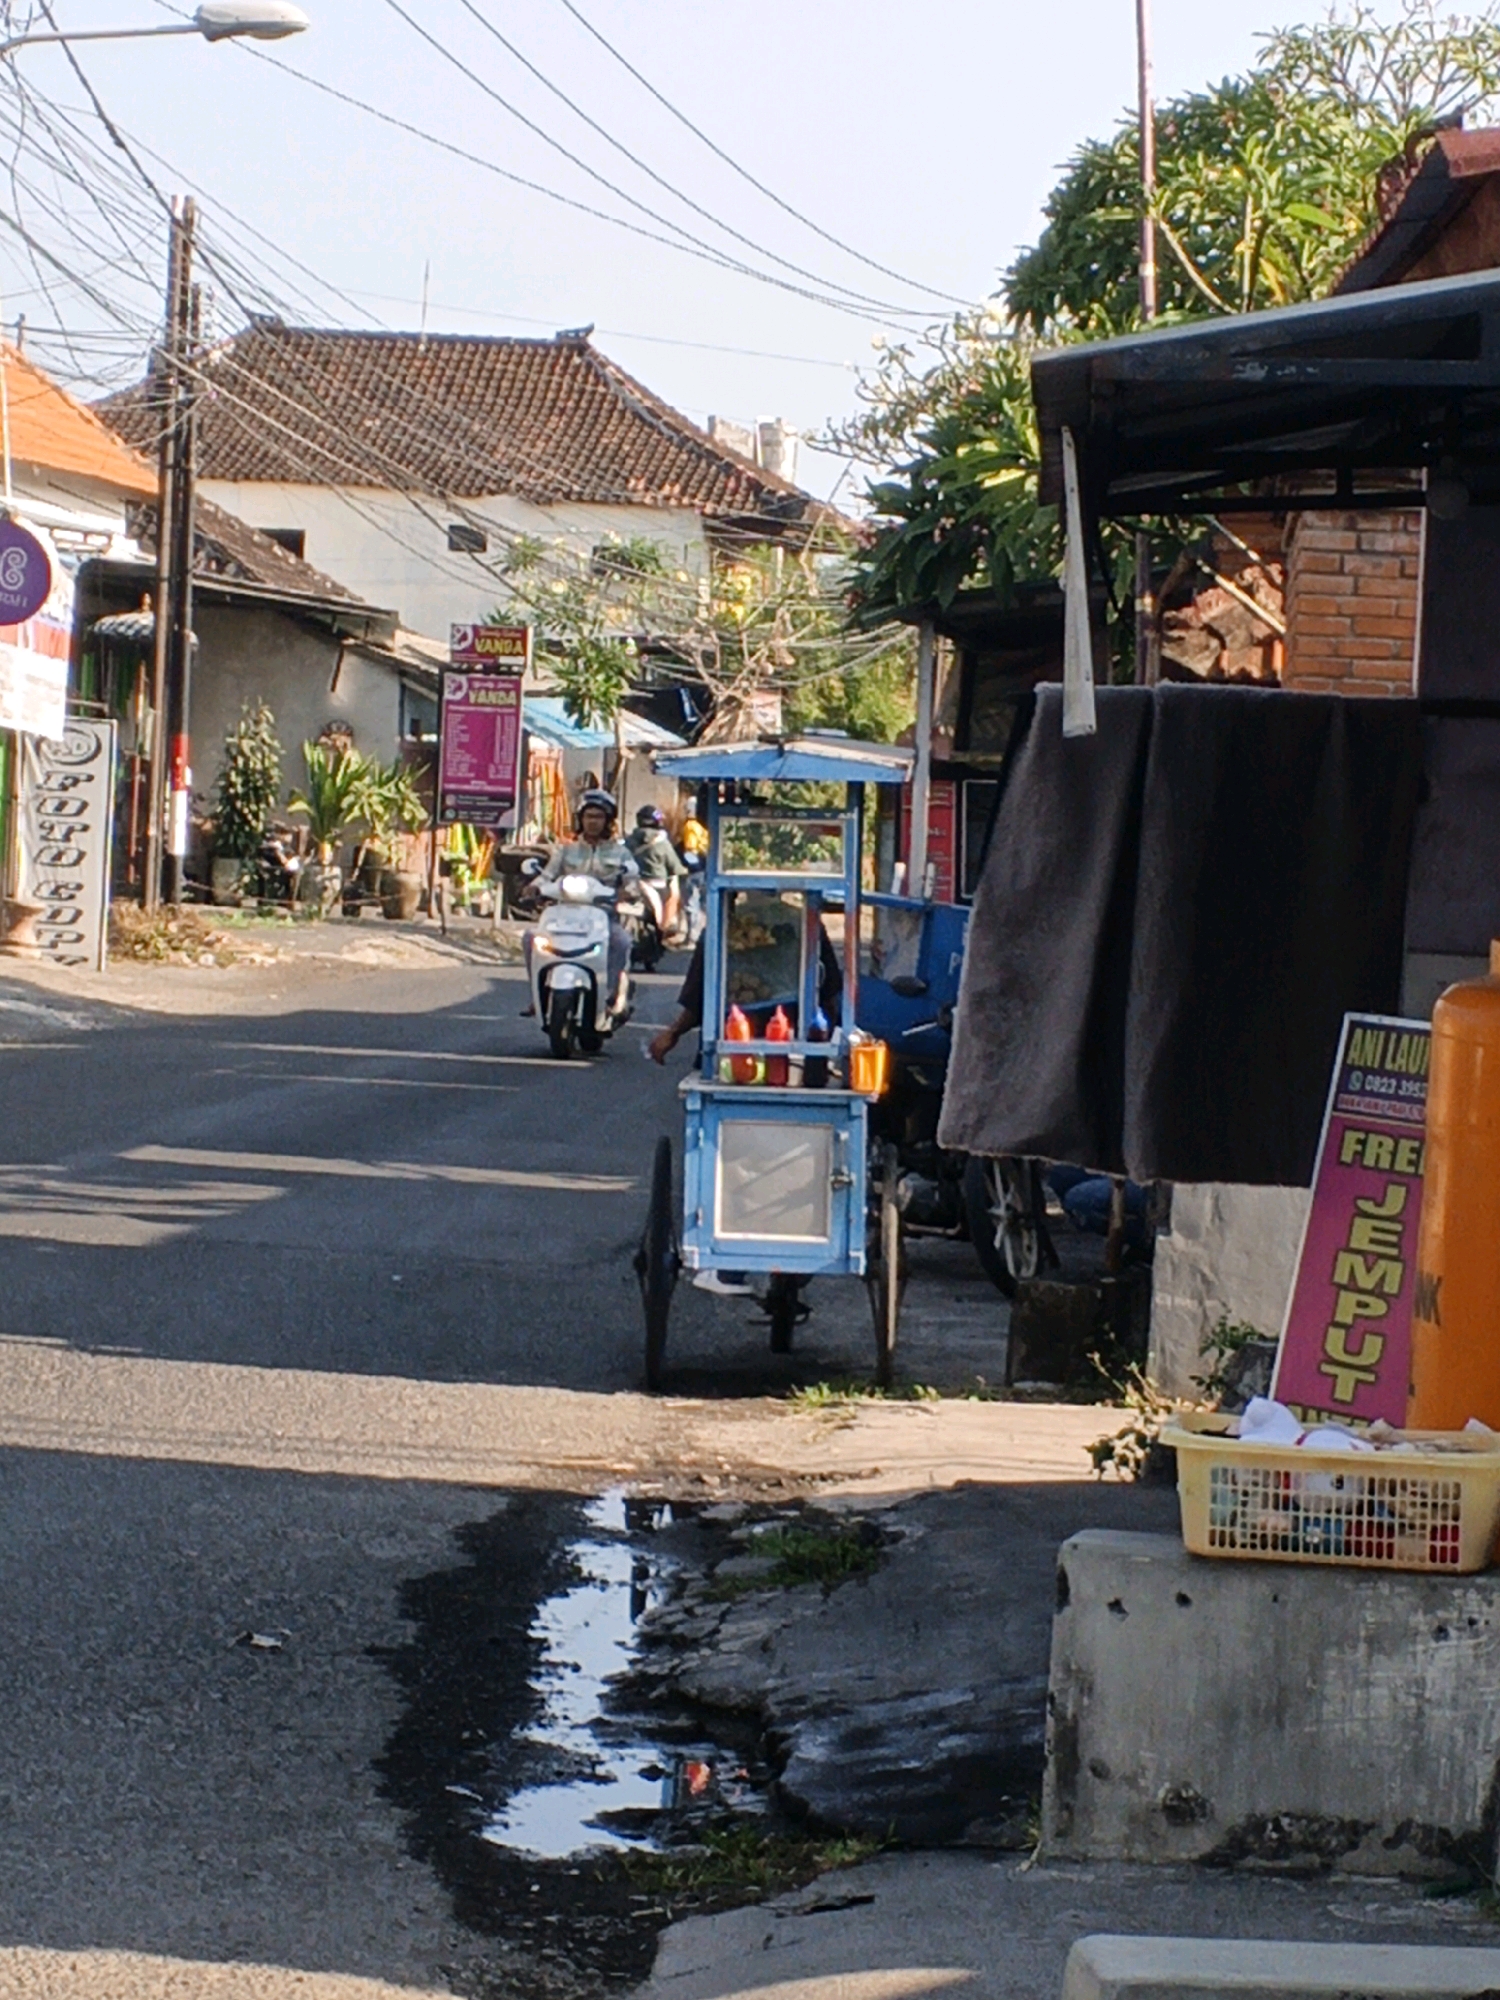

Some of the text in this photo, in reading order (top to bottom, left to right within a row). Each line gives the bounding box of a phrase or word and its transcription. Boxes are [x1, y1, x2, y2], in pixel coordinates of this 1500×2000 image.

[474, 637, 524, 655] VANDA
[468, 689, 517, 706] VANDA
[1346, 1027, 1386, 1069] ANI
[1340, 1129, 1423, 1174] FRE
[1320, 1182, 1407, 1403] JEMPUT
